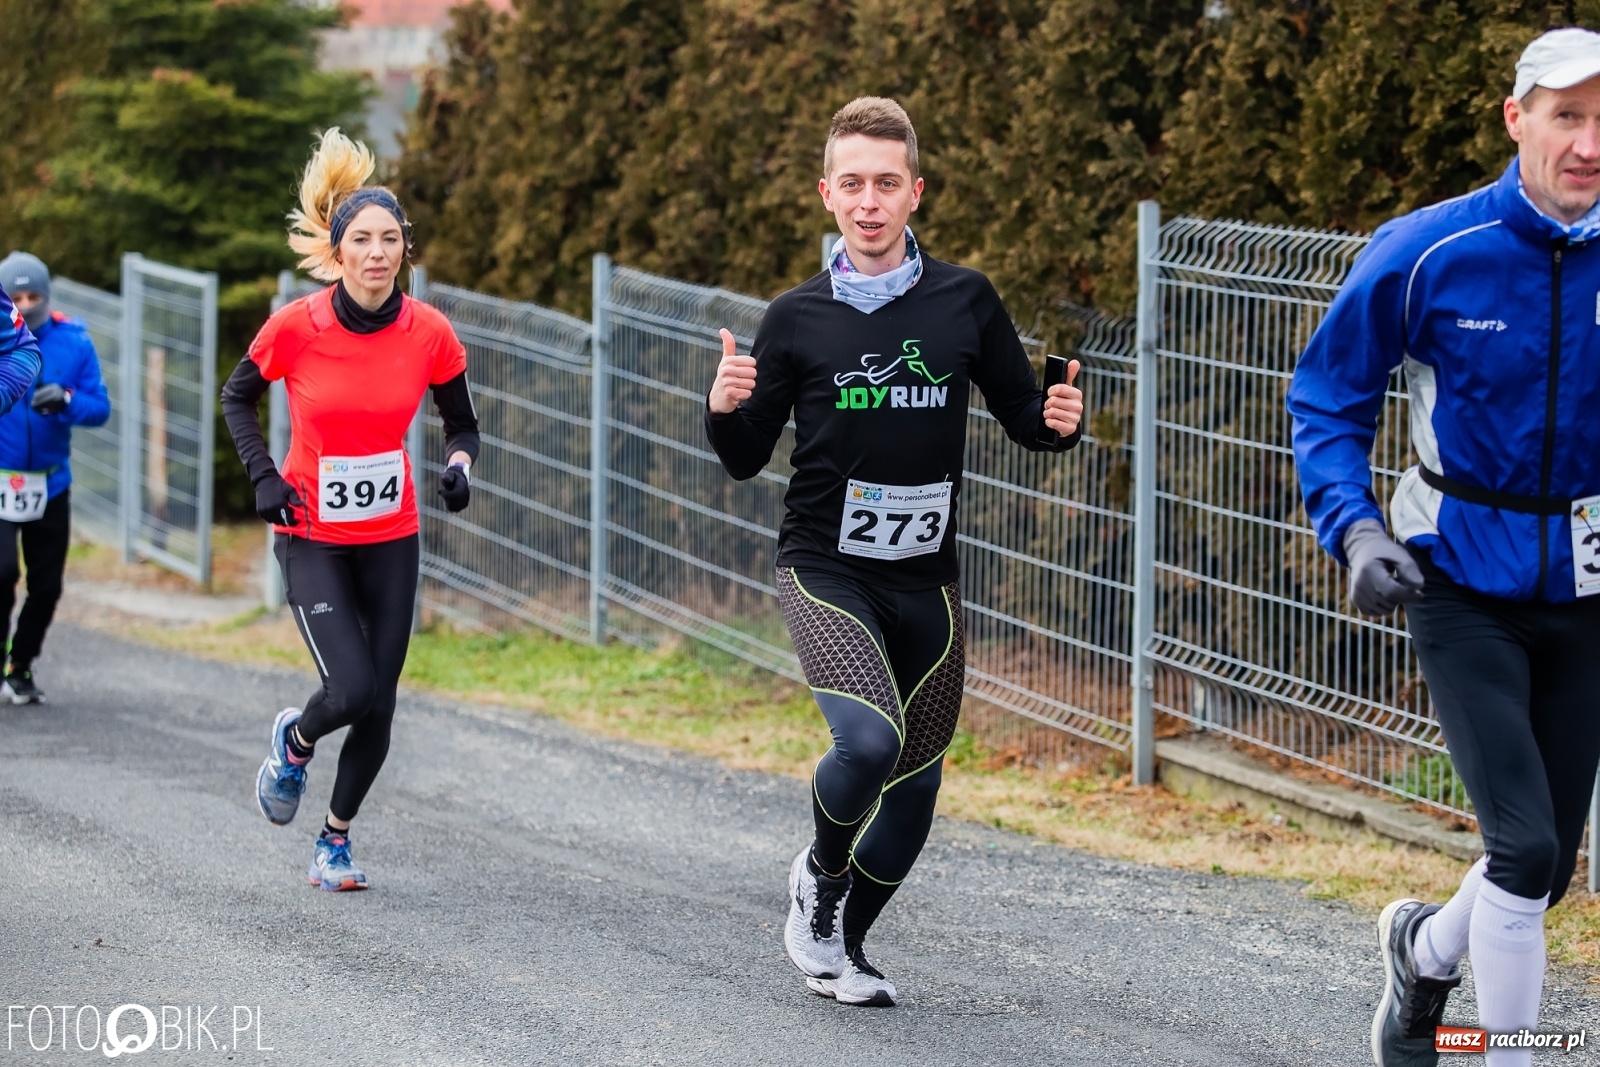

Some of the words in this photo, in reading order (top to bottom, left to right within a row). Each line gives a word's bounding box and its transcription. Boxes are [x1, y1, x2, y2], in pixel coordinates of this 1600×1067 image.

[1456, 318, 1497, 330] CRAFT
[835, 386, 948, 409] JOYRUN
[0, 491, 43, 512] 157
[325, 475, 399, 509] 394
[887, 490, 948, 502] www.personalbest.pl
[846, 509, 942, 546] 273
